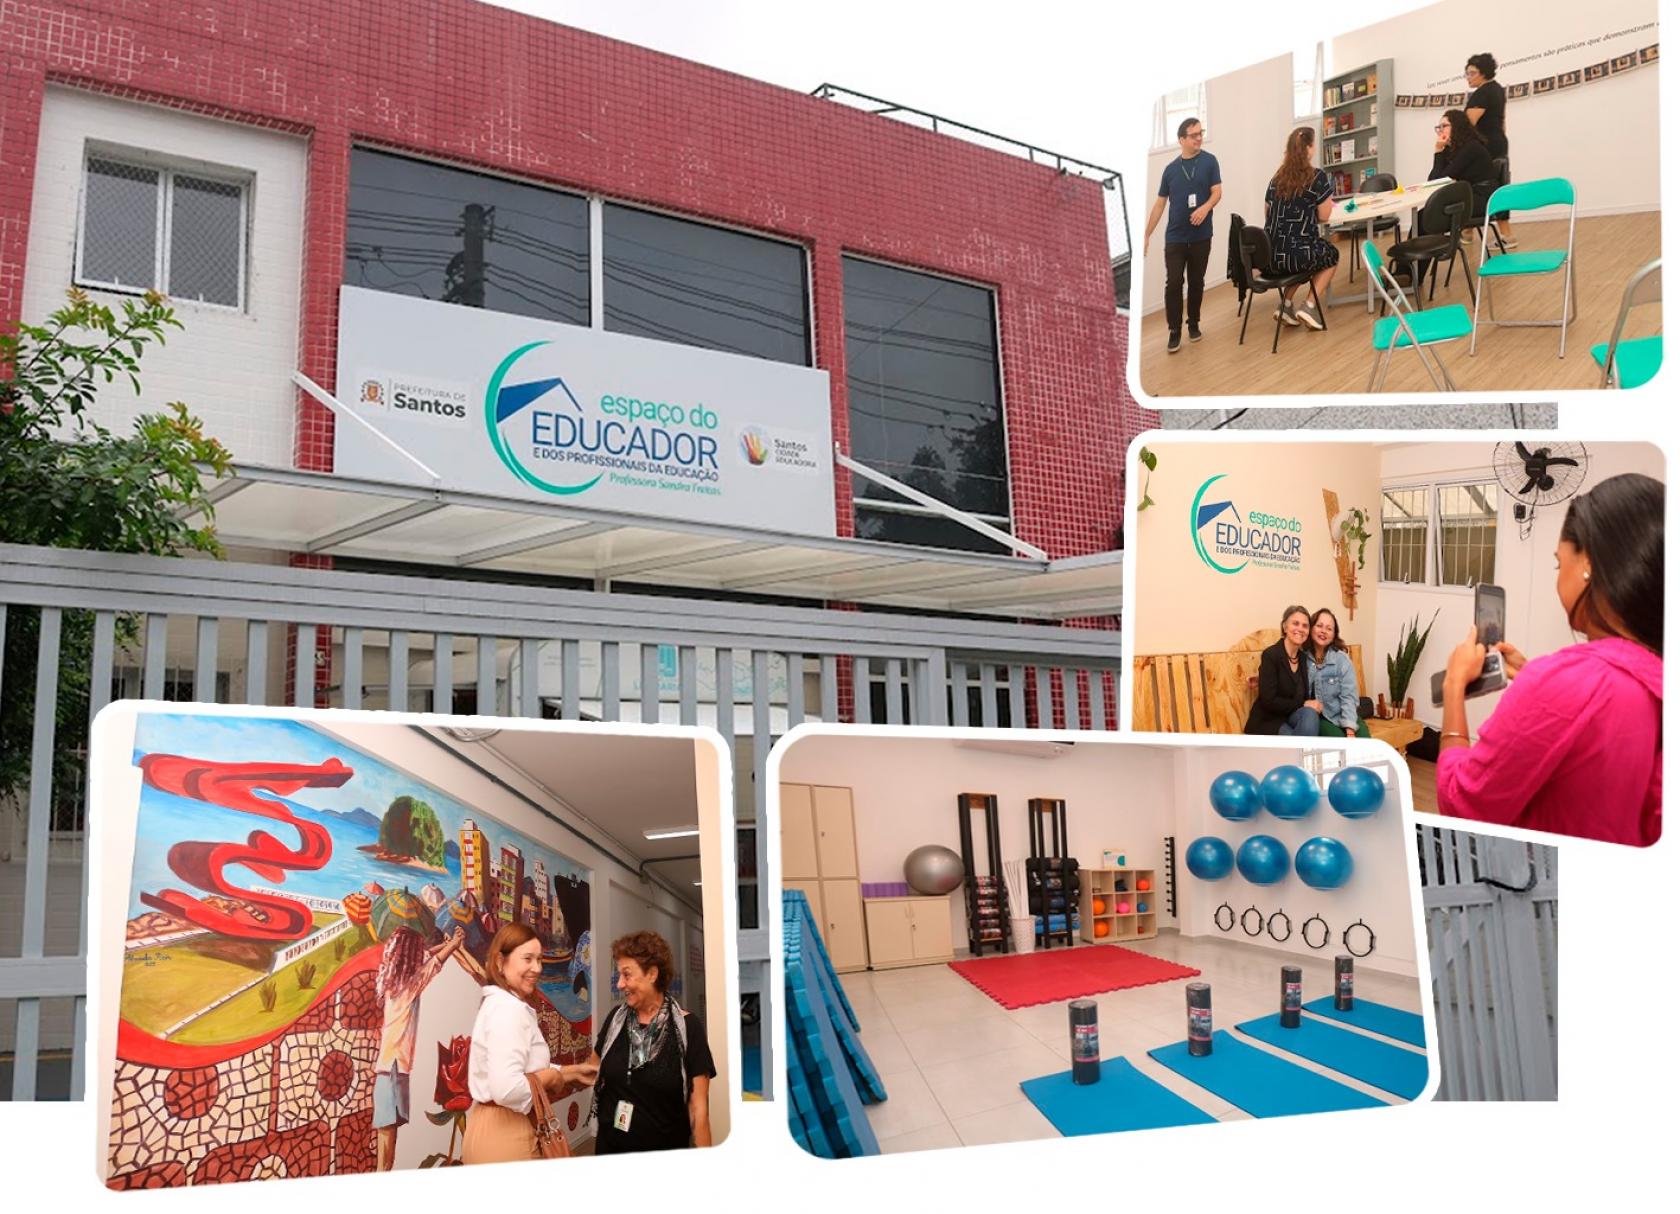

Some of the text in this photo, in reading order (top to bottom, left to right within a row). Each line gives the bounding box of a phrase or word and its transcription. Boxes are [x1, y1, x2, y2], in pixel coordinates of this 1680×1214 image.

[394, 392, 466, 418] Santos
[600, 394, 718, 430] espaço do
[532, 411, 719, 470] EDUCADOR
[533, 446, 720, 483] E DOS PROFISSIONAIS DA EDUCAÇÃO
[1216, 522, 1301, 556] EDUCADOR
[1249, 511, 1301, 533] espaço do
